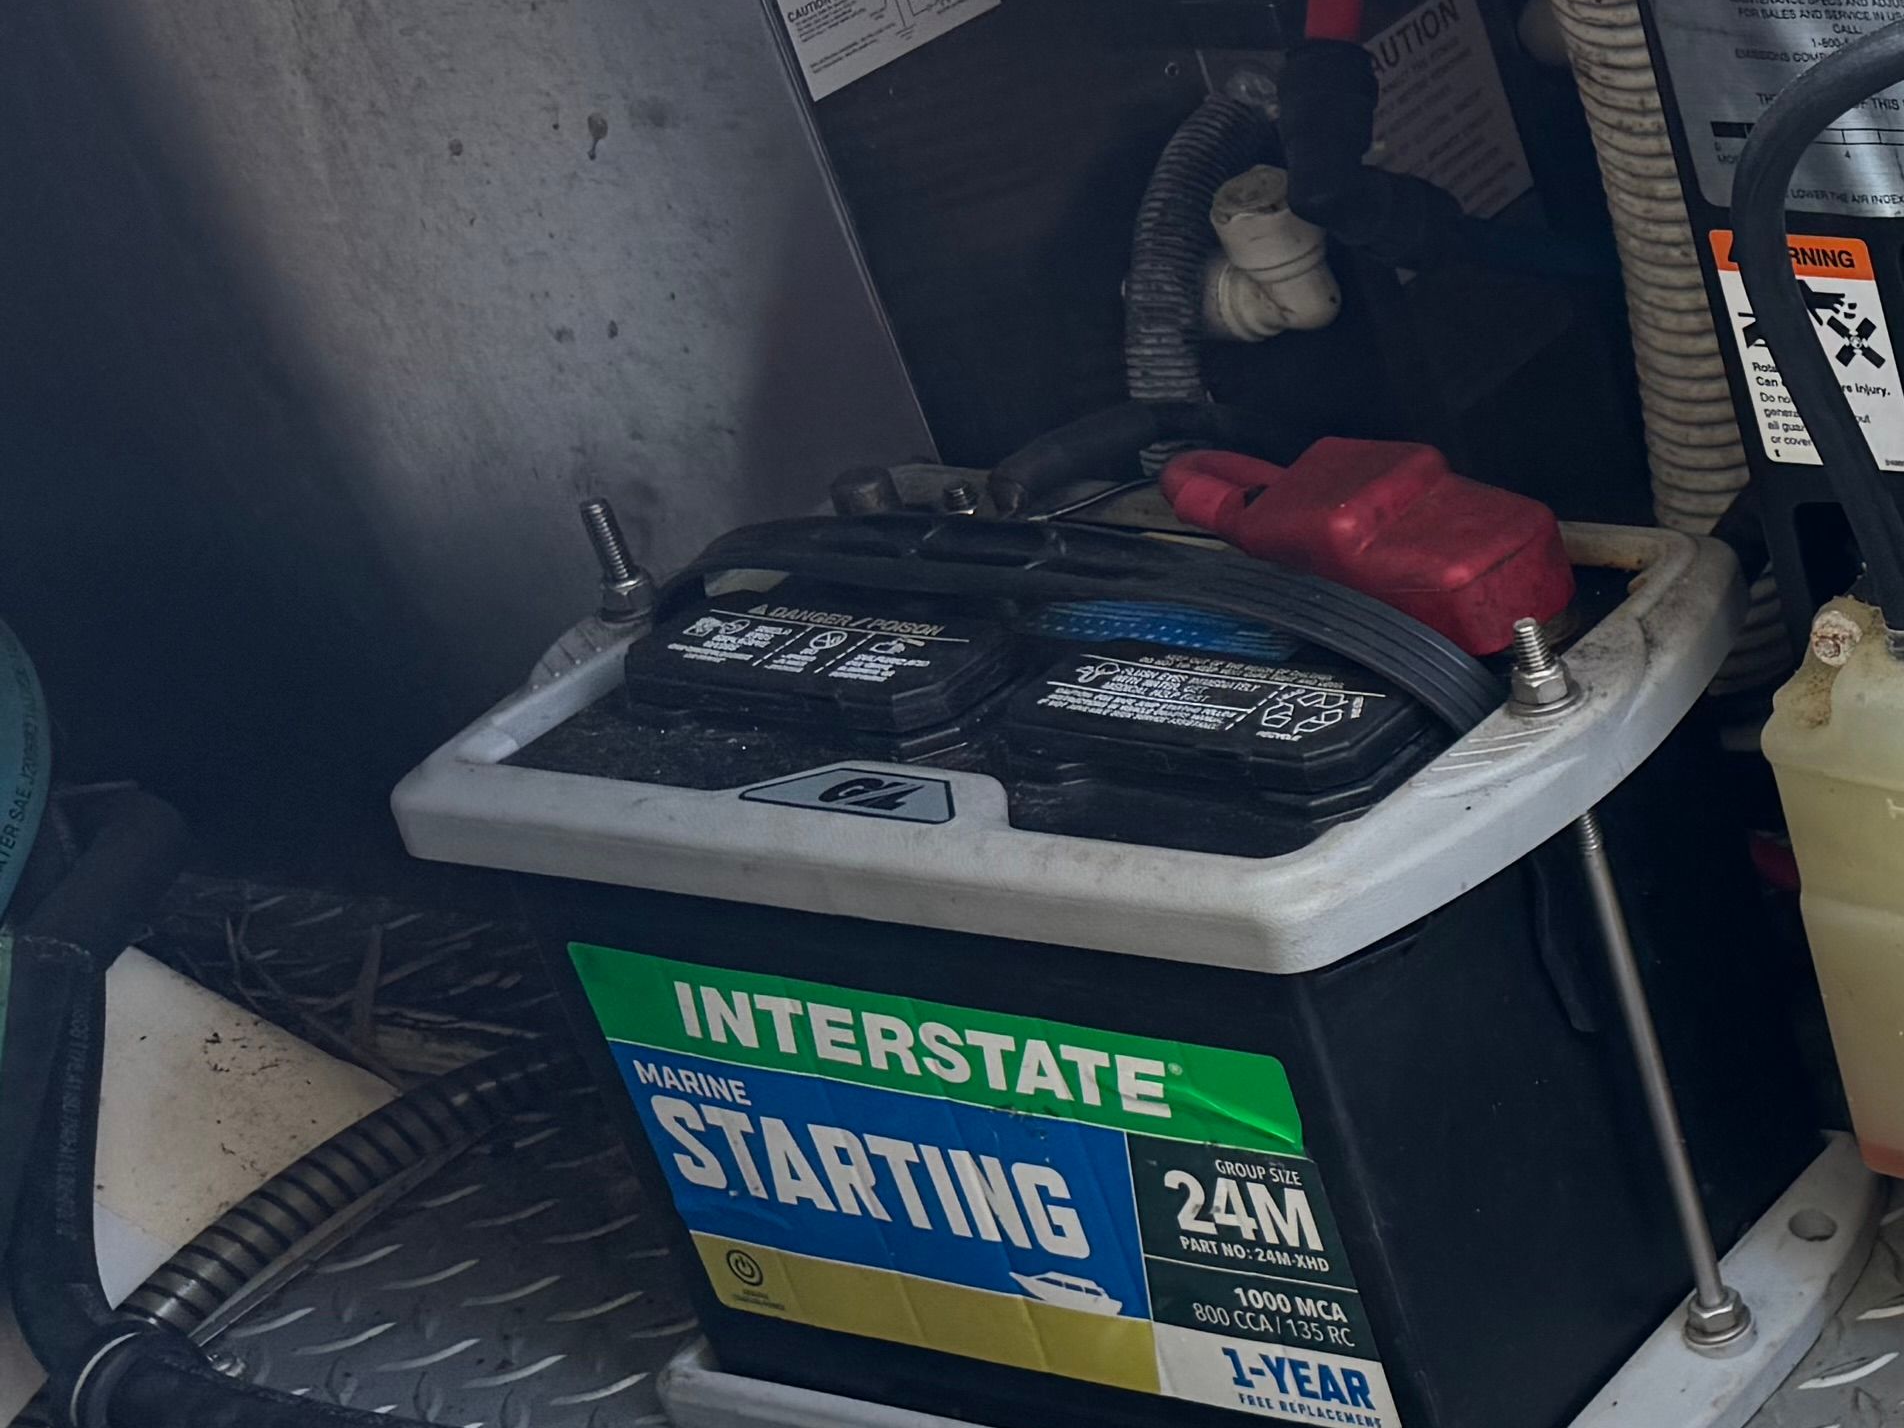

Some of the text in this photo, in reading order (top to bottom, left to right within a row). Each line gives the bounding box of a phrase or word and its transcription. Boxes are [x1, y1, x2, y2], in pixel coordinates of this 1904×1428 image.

[1870, 97, 1900, 111] THIS
[1790, 246, 1855, 268] RNING
[768, 606, 853, 626] DANGER
[868, 618, 945, 636] POISON
[673, 980, 1173, 1120] INTERSTATE
[632, 1060, 753, 1106] MARINE
[649, 1093, 1093, 1261] STARTING
[1213, 1157, 1304, 1189] GROUP SIZE
[1162, 1168, 1325, 1252] 24M
[1180, 1233, 1331, 1276] PART NO: 24M-XHD
[1191, 1301, 1231, 1326] 800
[1233, 1309, 1273, 1335] CCA
[1287, 1317, 1326, 1345] 135
[1328, 1326, 1358, 1351] RC
[1234, 1286, 1349, 1325] 1000 MCA
[1220, 1345, 1377, 1413] 1-YEAR
[1237, 1391, 1275, 1412] FREE
